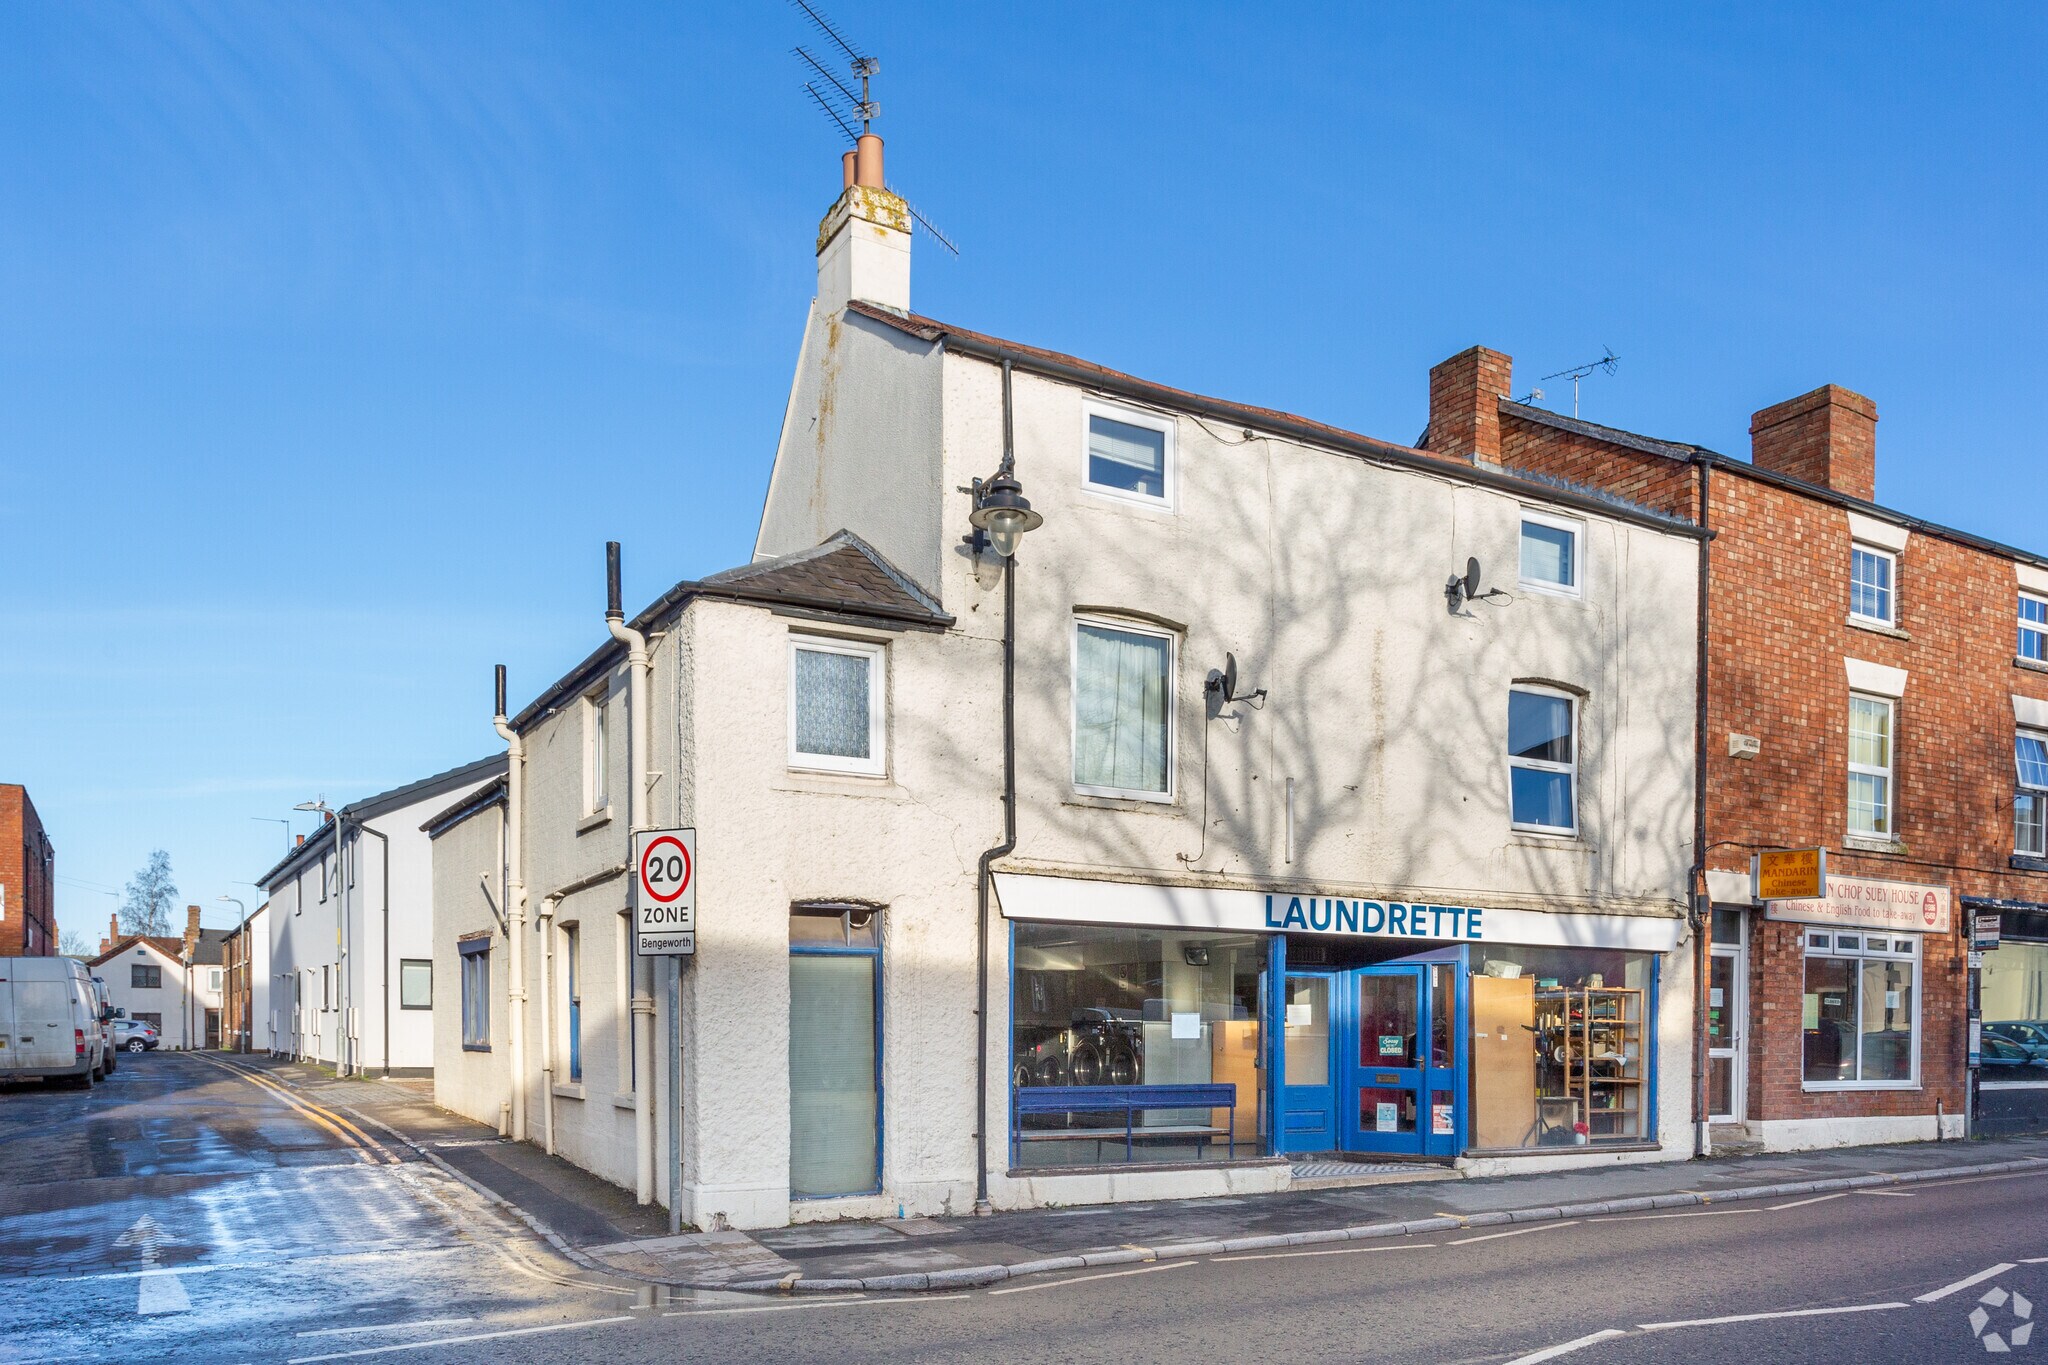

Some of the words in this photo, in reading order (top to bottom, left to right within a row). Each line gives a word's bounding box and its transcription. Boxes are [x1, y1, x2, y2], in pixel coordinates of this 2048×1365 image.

[649, 856, 683, 882] 20
[1763, 867, 1817, 878] MANDARIN
[1765, 887, 1813, 896] Take-away
[1771, 879, 1807, 888] Chinese
[1837, 884, 1863, 900] CHOP
[1865, 886, 1888, 902] SUEY
[1891, 889, 1920, 905] HOUSE
[644, 906, 689, 923] ZONE
[1265, 895, 1482, 939] LAUNDRETTE
[1785, 899, 1815, 913] Chinese
[1817, 901, 1823, 913] &
[1826, 903, 1852, 918] English
[1854, 905, 1871, 917] Food
[1873, 907, 1880, 918] to
[1882, 908, 1917, 924] take-away
[641, 937, 691, 950] Bengeworth
